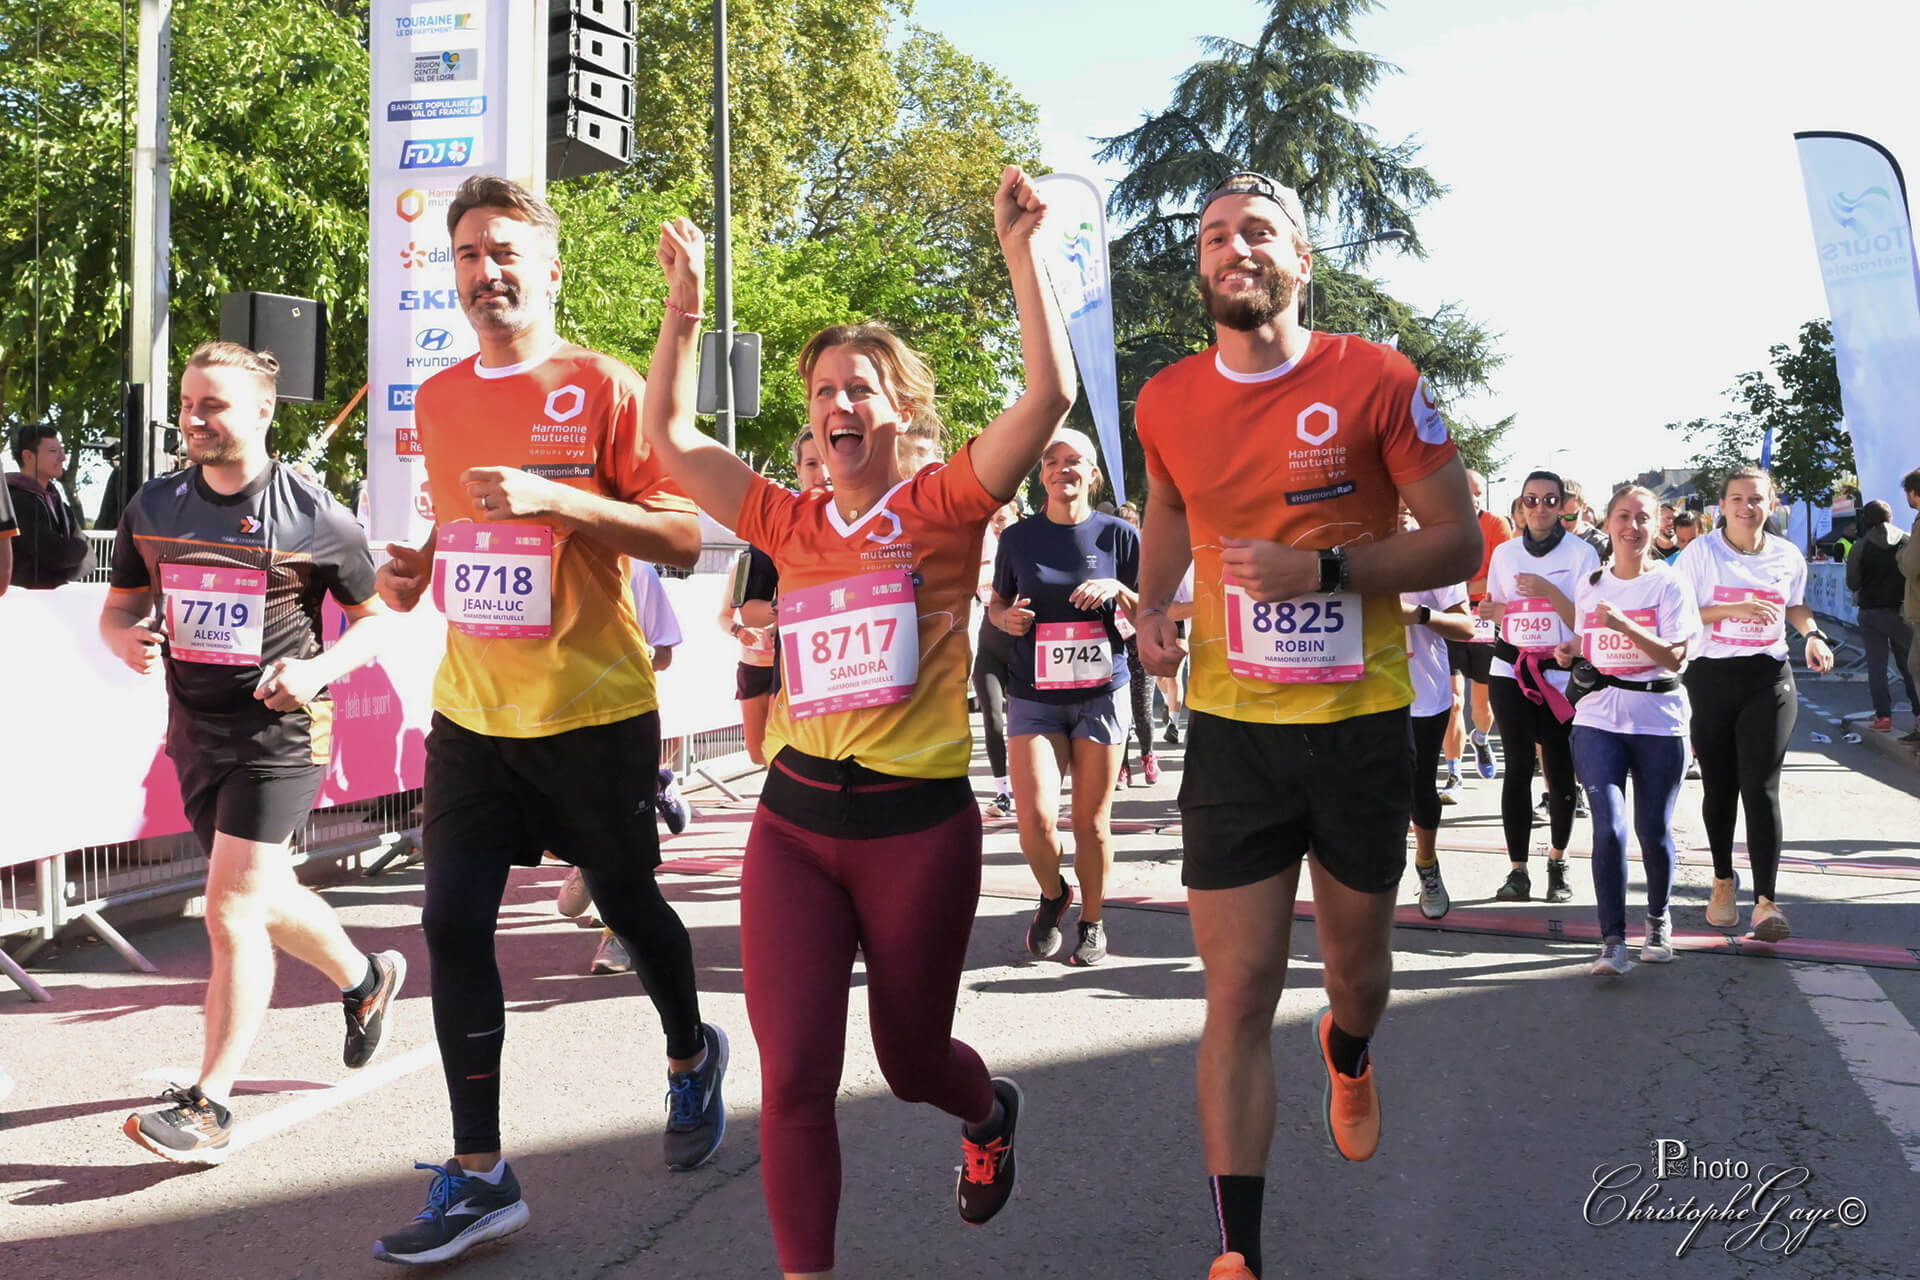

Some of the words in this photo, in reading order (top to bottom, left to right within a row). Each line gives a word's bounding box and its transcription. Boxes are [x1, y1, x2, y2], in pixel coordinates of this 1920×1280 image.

[396, 14, 452, 28] TOURAINE
[414, 67, 439, 75] CENTRE
[391, 102, 423, 111] BANQUE
[403, 142, 447, 164] FDJ
[400, 430, 408, 441] la
[532, 424, 587, 434] Harmonie
[530, 433, 586, 443] mutuelle
[1288, 445, 1347, 459] Harmonie
[1288, 455, 1347, 469] mutuelle
[860, 551, 912, 560] mutuelle
[455, 564, 533, 595] 8718
[463, 598, 524, 611] JEAN-LUC
[181, 600, 248, 627] 7719
[1252, 601, 1344, 633] 8825
[1513, 617, 1551, 632] 7949
[194, 630, 231, 641] ALEXIS
[811, 618, 897, 664] 8717
[1275, 640, 1325, 652] ROBIN
[1052, 645, 1102, 664] 9742
[829, 659, 889, 680] SANDRA
[827, 681, 860, 692] HARMONIE
[861, 674, 894, 687] MUTUELLE
